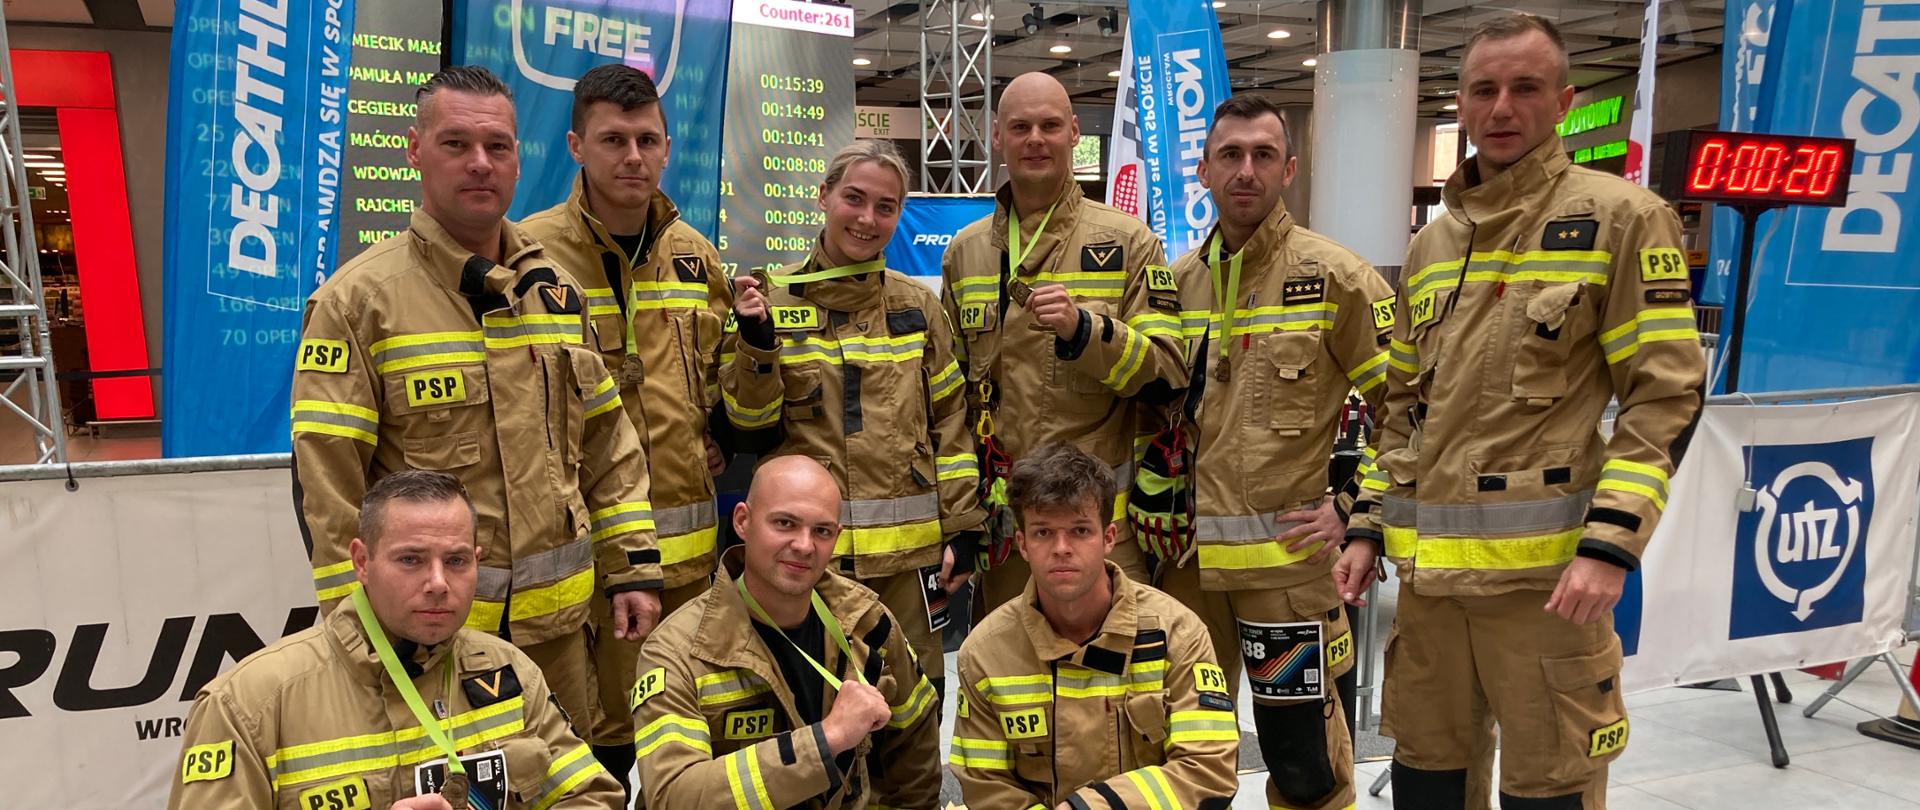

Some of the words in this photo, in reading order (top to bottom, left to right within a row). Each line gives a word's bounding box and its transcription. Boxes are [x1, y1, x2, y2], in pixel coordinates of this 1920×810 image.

[760, 3, 850, 28] Counter:261
[544, 6, 651, 62] FREE
[322, 45, 340, 76] W
[761, 74, 824, 93] 00:15:39
[320, 83, 346, 124] SIĘ
[761, 102, 825, 120] 00:14:49
[762, 129, 825, 147] 00:10:41
[874, 128, 890, 136] EXIT
[763, 156, 826, 173] 00:08:08
[1691, 139, 1842, 195] 0:00:20
[764, 183, 820, 199] 00:14:2
[765, 210, 826, 225] 00:09:24
[1648, 253, 1681, 274] PSP
[1152, 270, 1172, 286] PSP
[779, 310, 810, 323] PSP
[303, 344, 342, 366] PSP
[414, 375, 457, 400] PSP
[1331, 638, 1348, 661] PSP
[732, 714, 768, 735] PSP
[1005, 713, 1041, 734] PSP
[1598, 727, 1624, 750] PSP
[186, 748, 226, 776] PSP
[309, 784, 358, 810] PSP
